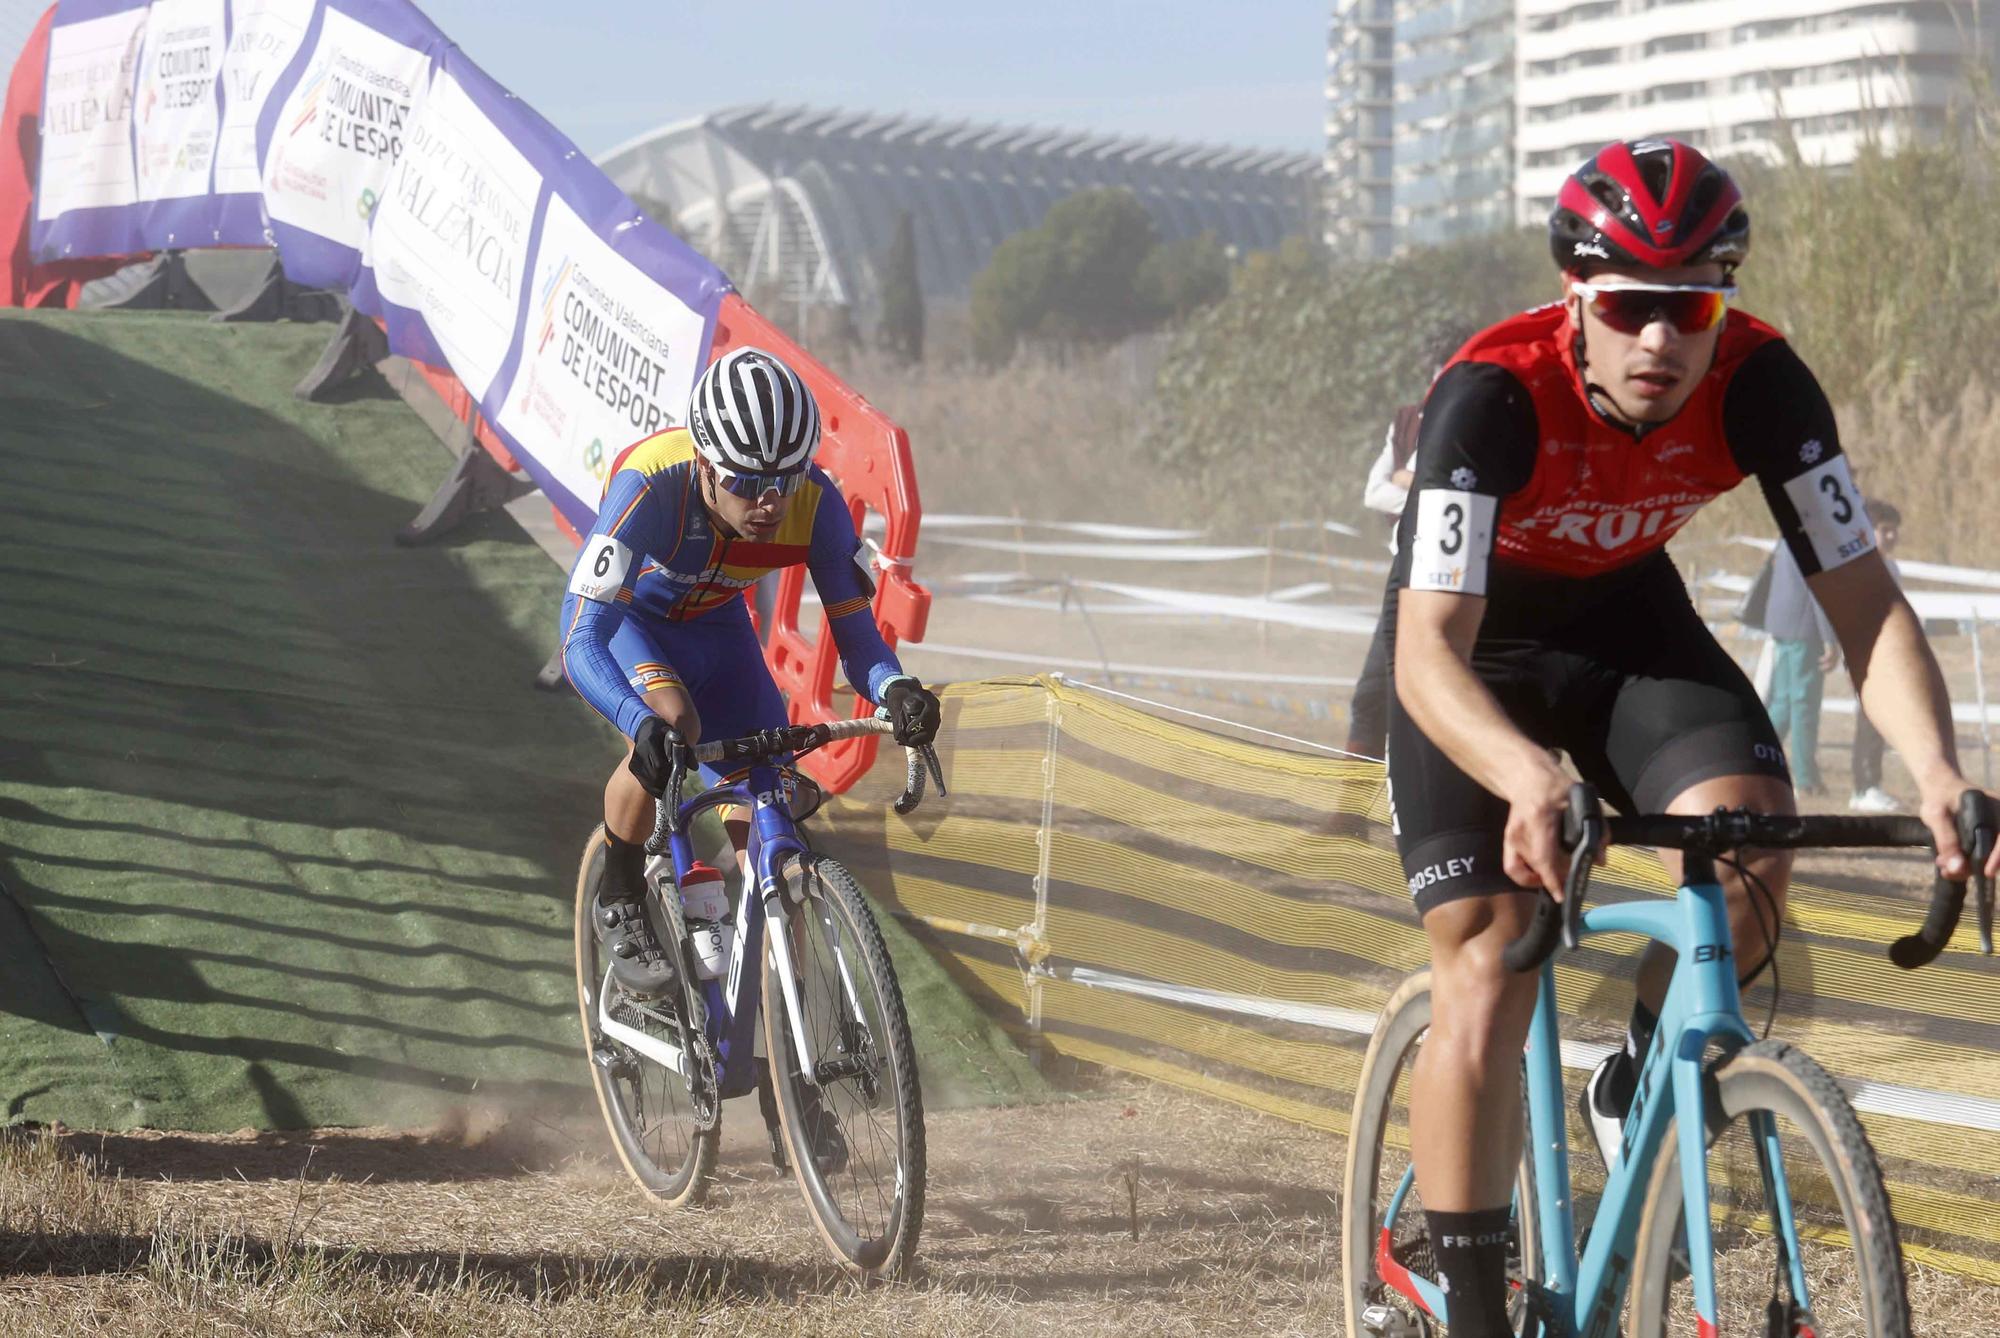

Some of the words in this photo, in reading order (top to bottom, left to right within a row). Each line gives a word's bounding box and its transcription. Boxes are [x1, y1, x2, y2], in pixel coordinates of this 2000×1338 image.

[561, 333, 582, 378] DE
[563, 291, 665, 398] COMUNITAT
[615, 304, 669, 359] Valenciana
[693, 410, 711, 447] LAZER
[1820, 475, 1852, 525] 3
[1440, 503, 1463, 555] 3
[594, 545, 614, 577] 6
